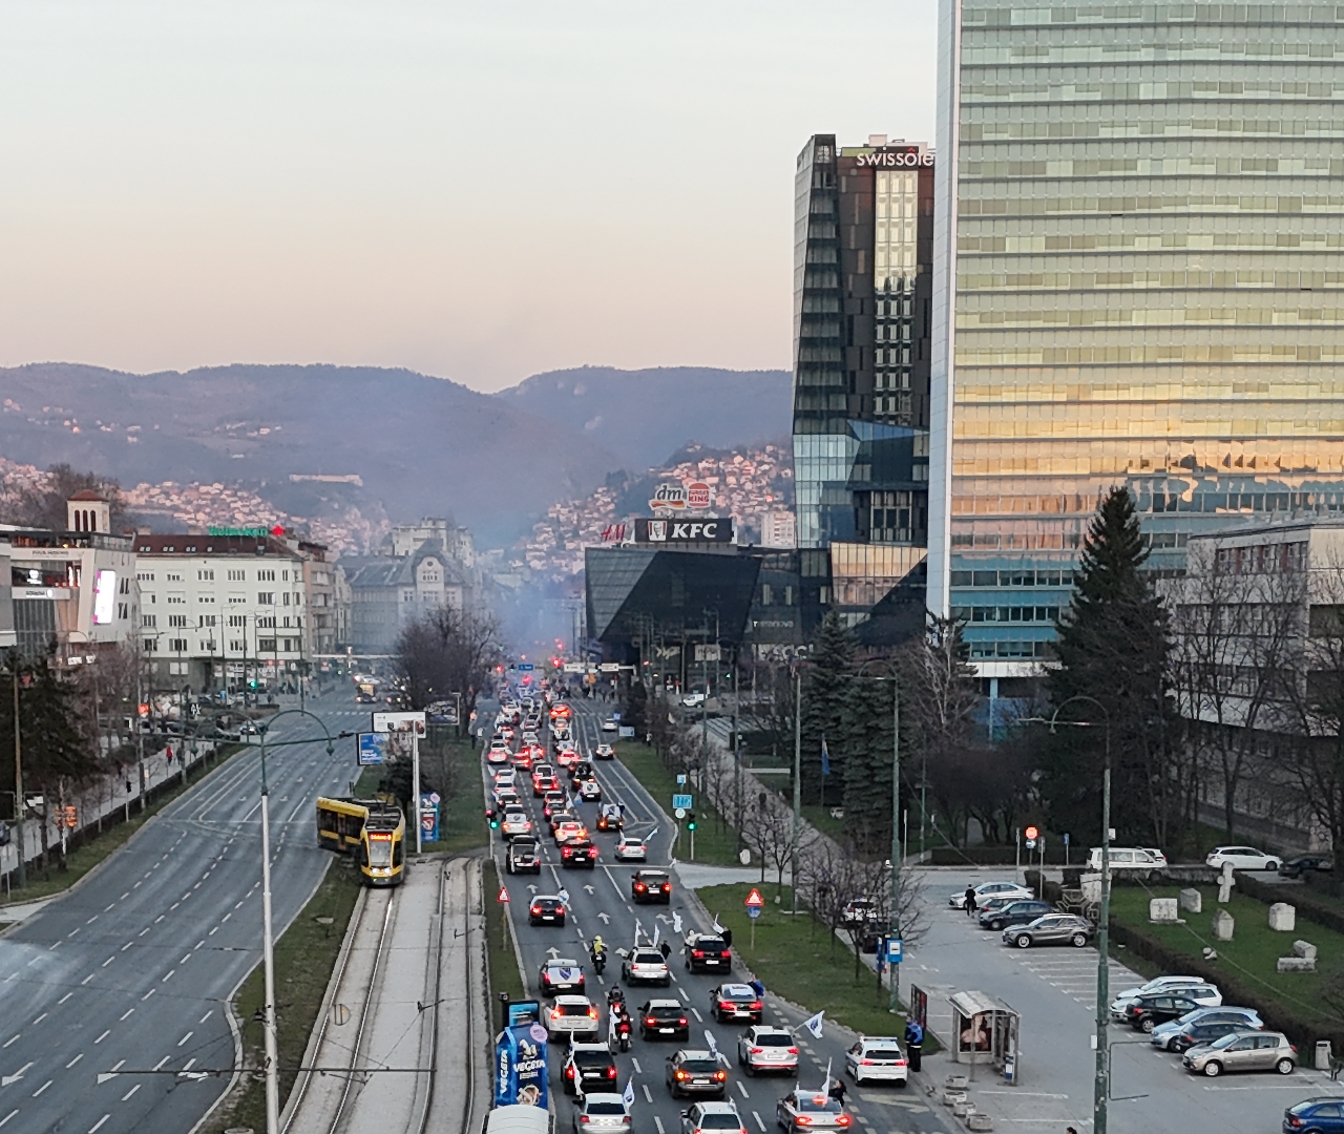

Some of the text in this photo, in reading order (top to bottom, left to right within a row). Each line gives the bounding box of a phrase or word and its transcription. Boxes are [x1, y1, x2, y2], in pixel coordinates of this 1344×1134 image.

[856, 147, 934, 167] swissôte
[656, 485, 682, 500] dm
[671, 523, 717, 538] KFC
[499, 1049, 509, 1095] VEGETA
[513, 1060, 545, 1072] VEGETA
